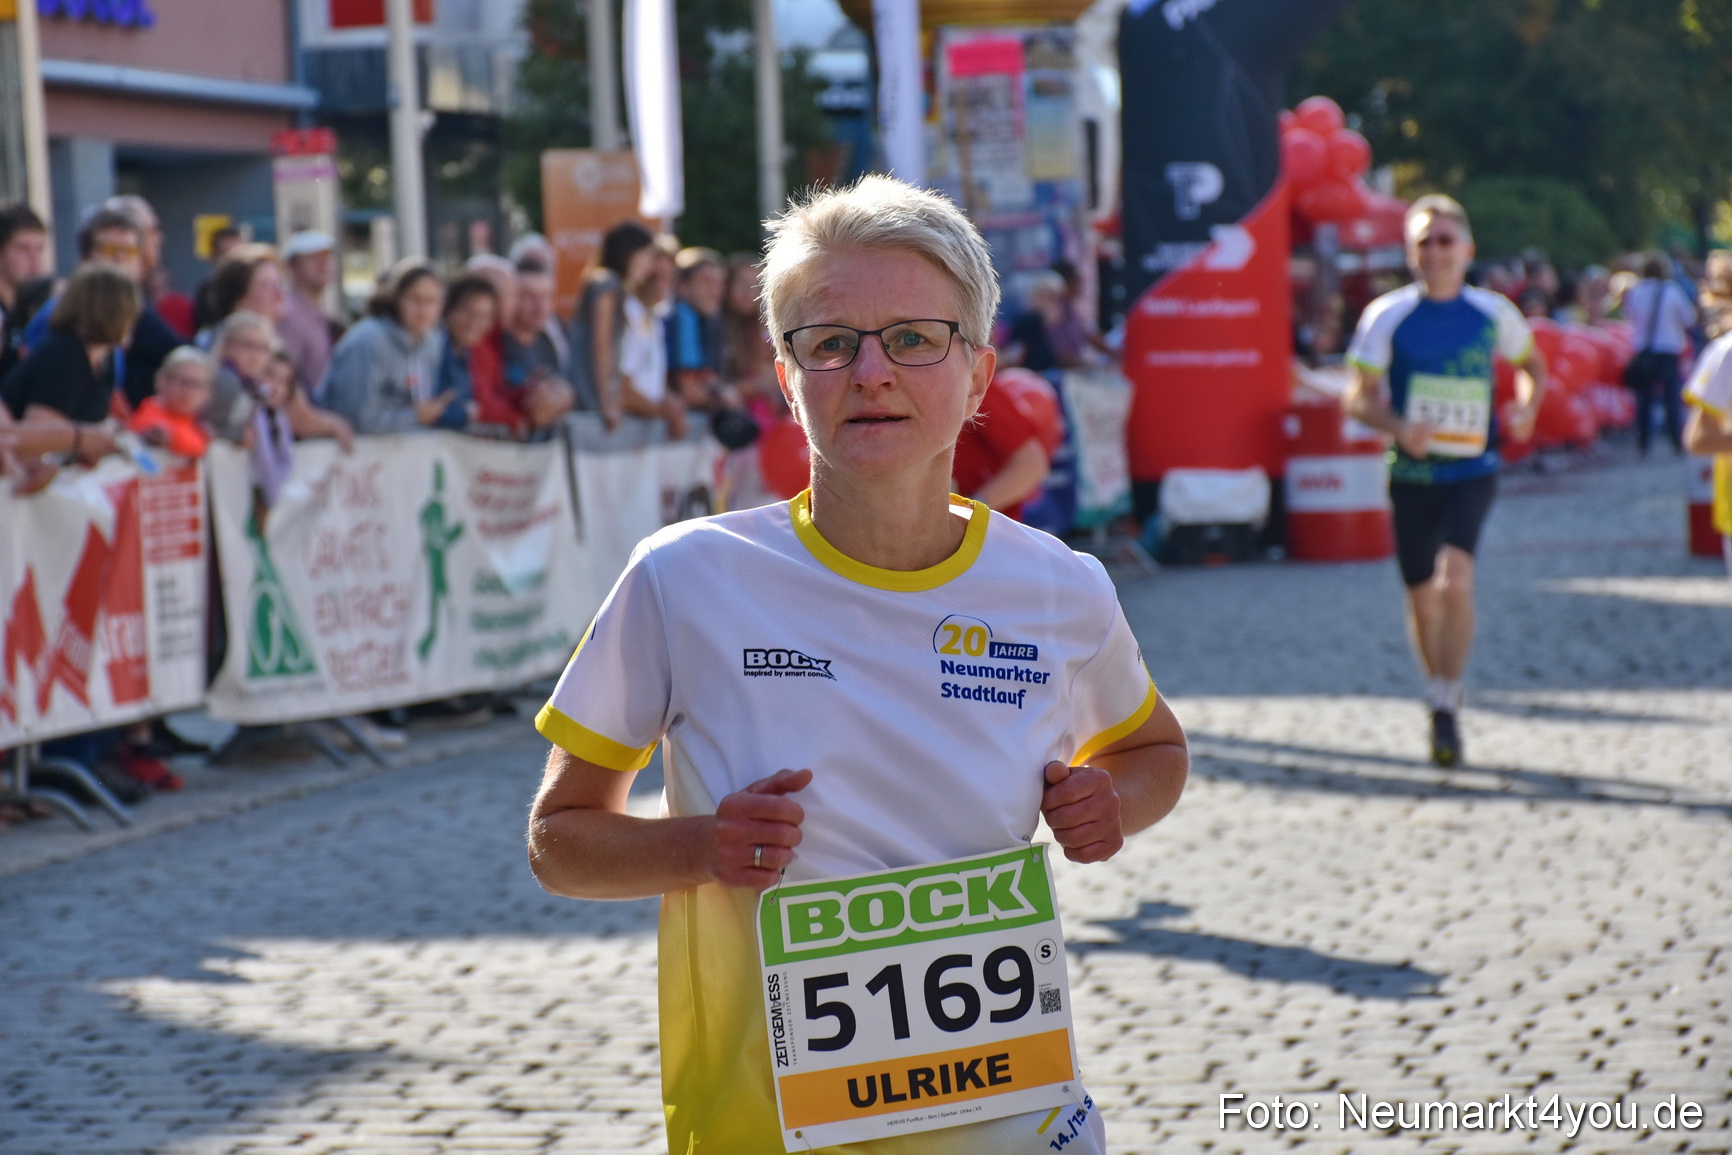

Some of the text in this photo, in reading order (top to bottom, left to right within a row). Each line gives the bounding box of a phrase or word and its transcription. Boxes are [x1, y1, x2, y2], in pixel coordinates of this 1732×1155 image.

[940, 624, 987, 657] 20
[993, 645, 1034, 658] JAHRE
[743, 648, 834, 678] BOCK
[743, 670, 773, 678] inspired
[940, 660, 1050, 684] Neumarkter
[941, 682, 1027, 709] Stadtlauf
[780, 859, 1038, 953] BOCK
[803, 945, 1035, 1052] 5169
[783, 971, 798, 1065] TRANSPONDER ZEITMESSUNG
[847, 1053, 1012, 1108] ULRIKE
